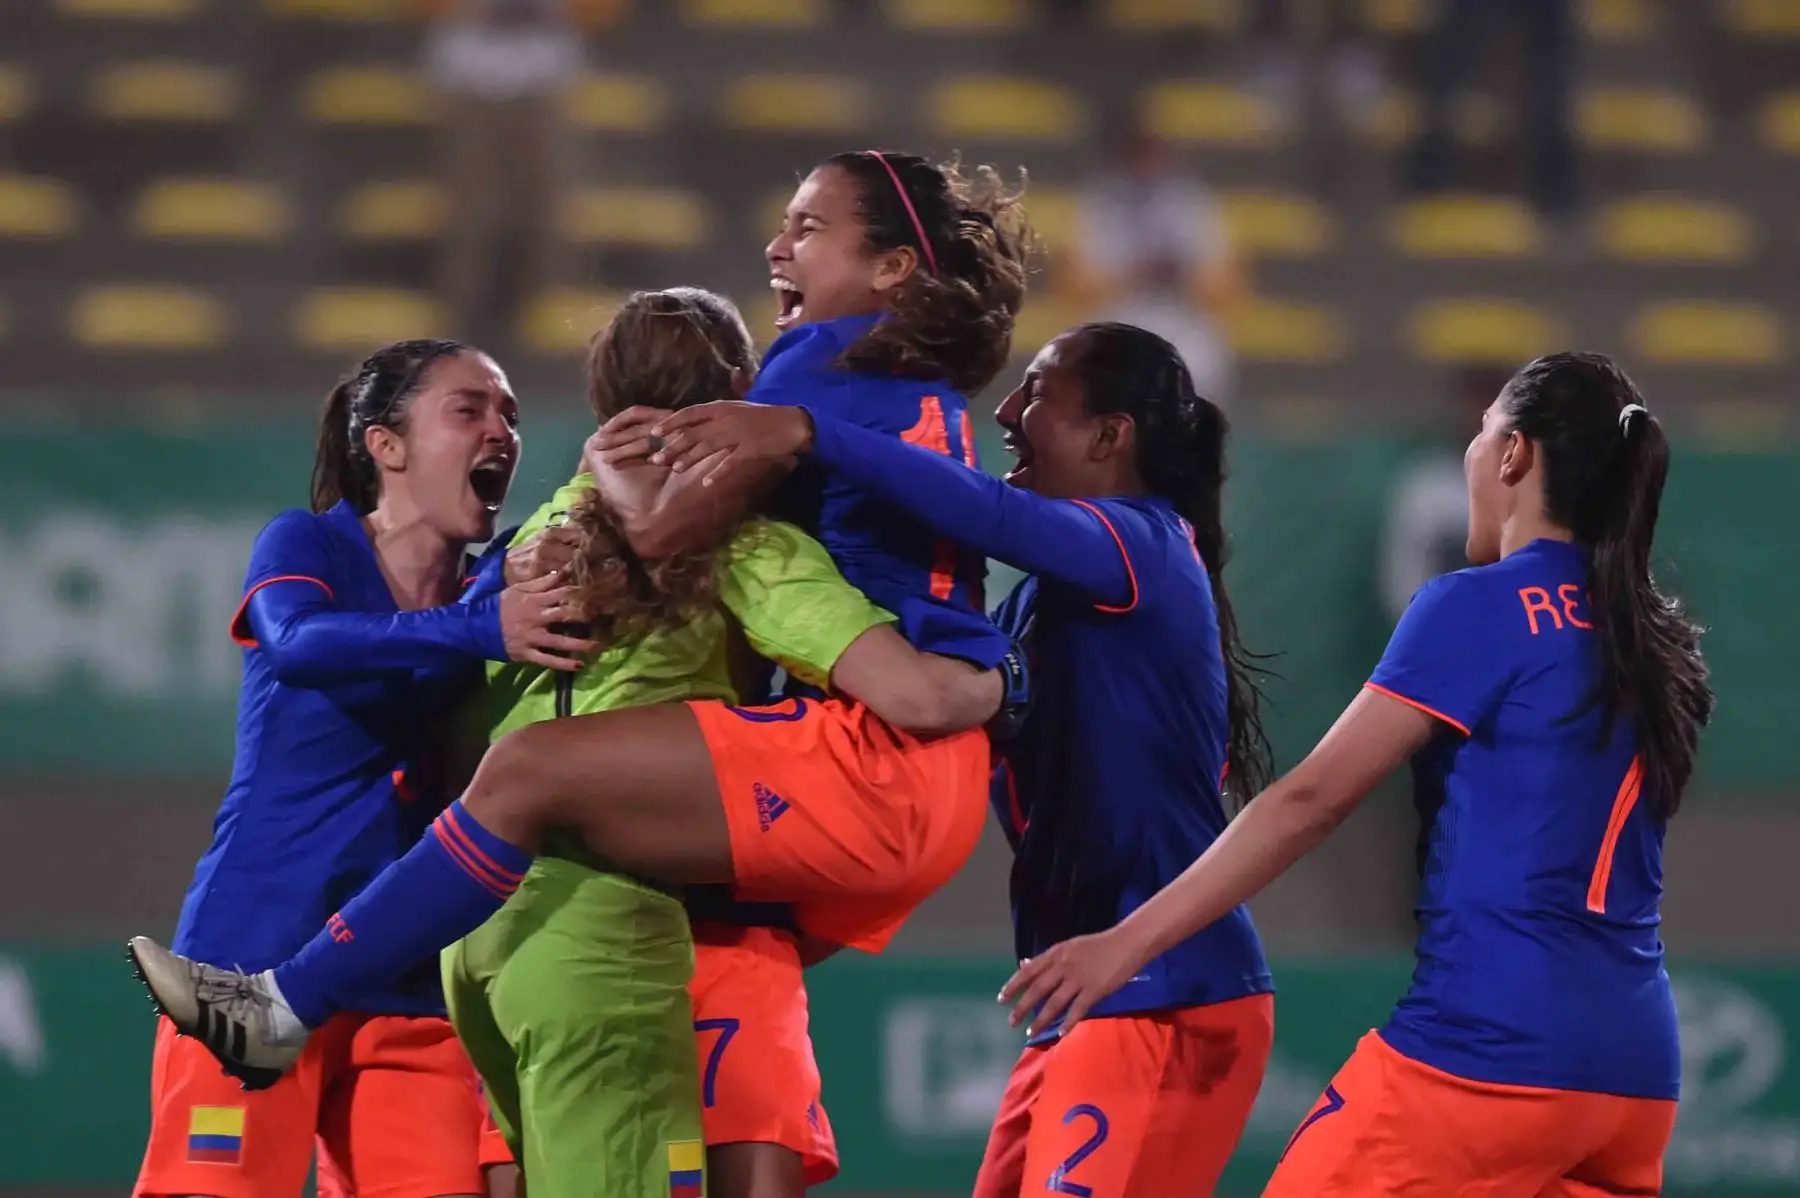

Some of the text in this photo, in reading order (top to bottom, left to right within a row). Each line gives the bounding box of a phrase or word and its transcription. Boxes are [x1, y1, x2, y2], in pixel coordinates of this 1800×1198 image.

[1518, 583, 1597, 634] RE
[753, 782, 771, 833] adidas
[1045, 1103, 1109, 1198] 2
